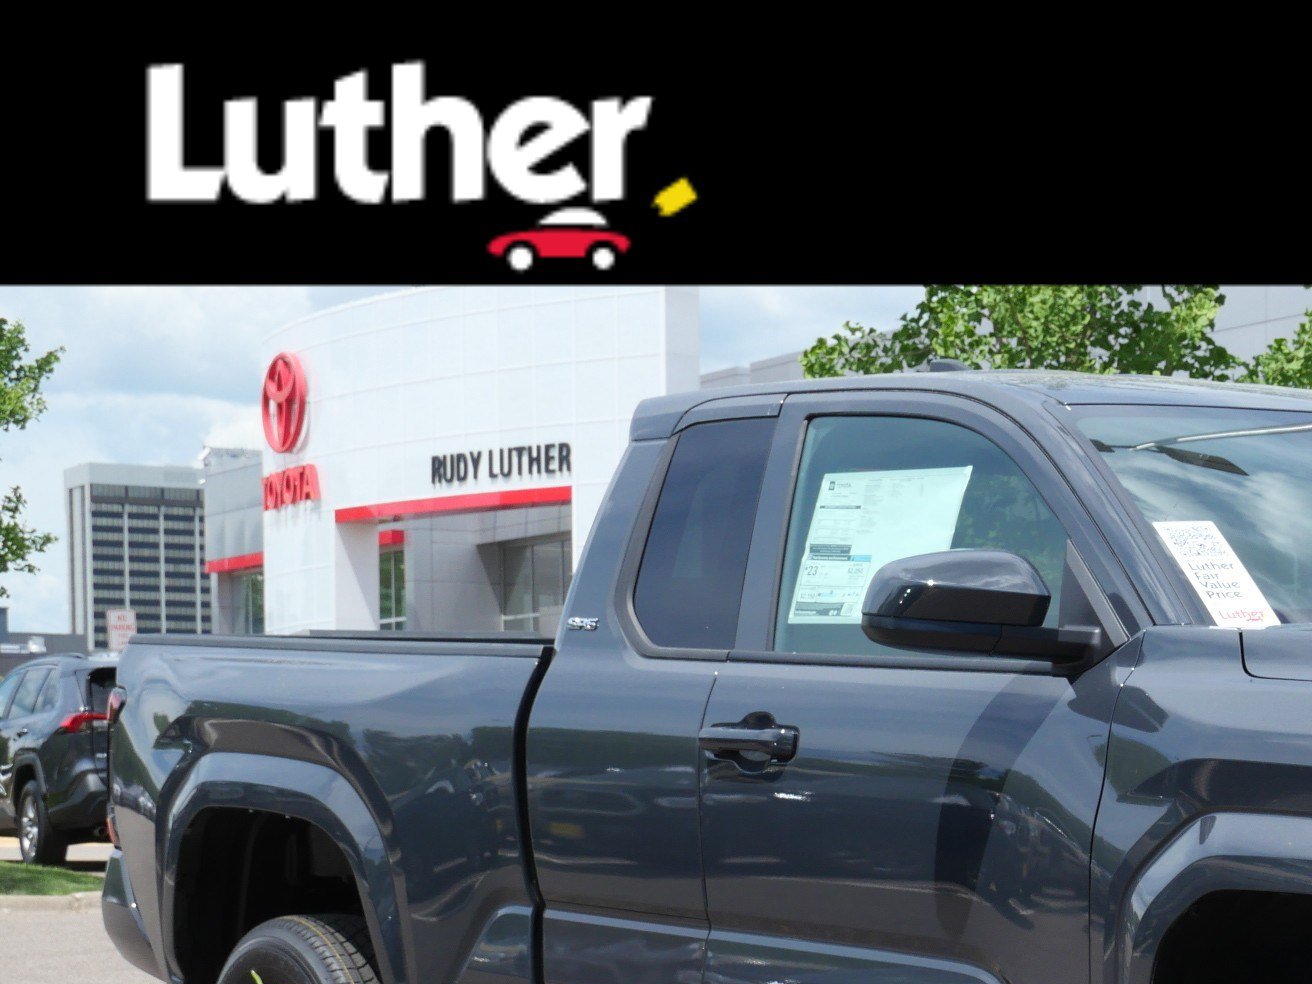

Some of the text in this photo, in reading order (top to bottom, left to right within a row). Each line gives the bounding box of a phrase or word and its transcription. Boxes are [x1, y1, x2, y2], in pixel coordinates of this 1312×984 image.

[431, 442, 572, 484] RUDY LUTHER
[262, 464, 321, 511] TOYOTA
[1187, 561, 1235, 571] Luther
[1194, 572, 1220, 580] Fair
[1199, 581, 1241, 589] Value
[1206, 590, 1243, 599] Price
[1219, 609, 1265, 620] Luther
